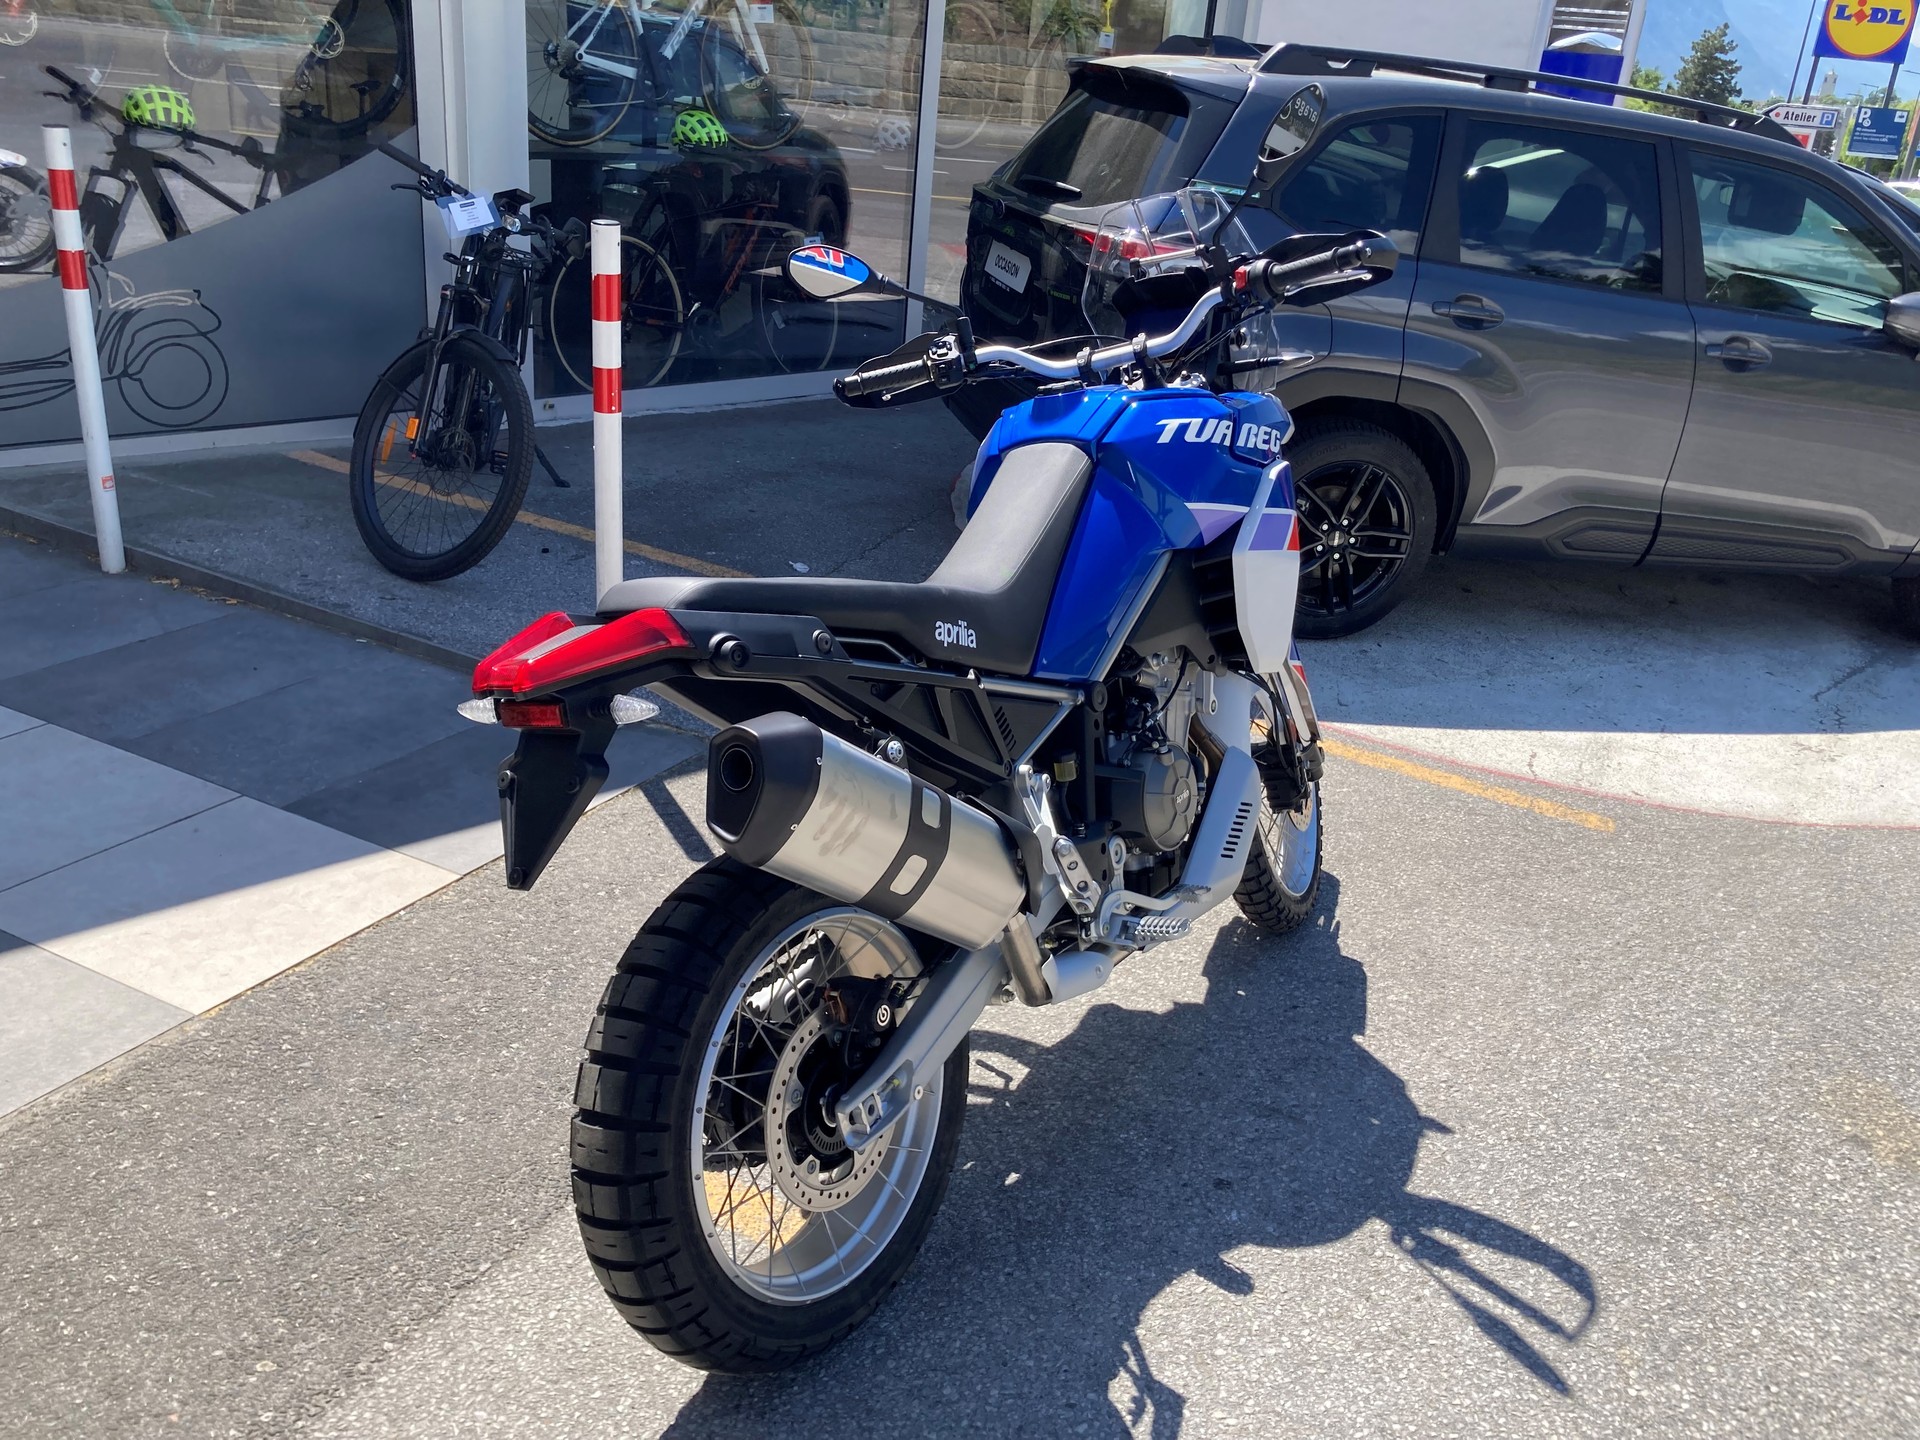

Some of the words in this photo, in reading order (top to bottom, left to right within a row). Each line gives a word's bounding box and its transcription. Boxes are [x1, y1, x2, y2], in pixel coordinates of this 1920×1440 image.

[1783, 110, 1817, 123] Atelier
[1822, 113, 1832, 125] P
[994, 254, 1020, 279] OCCASION
[935, 619, 977, 649] aprilia
